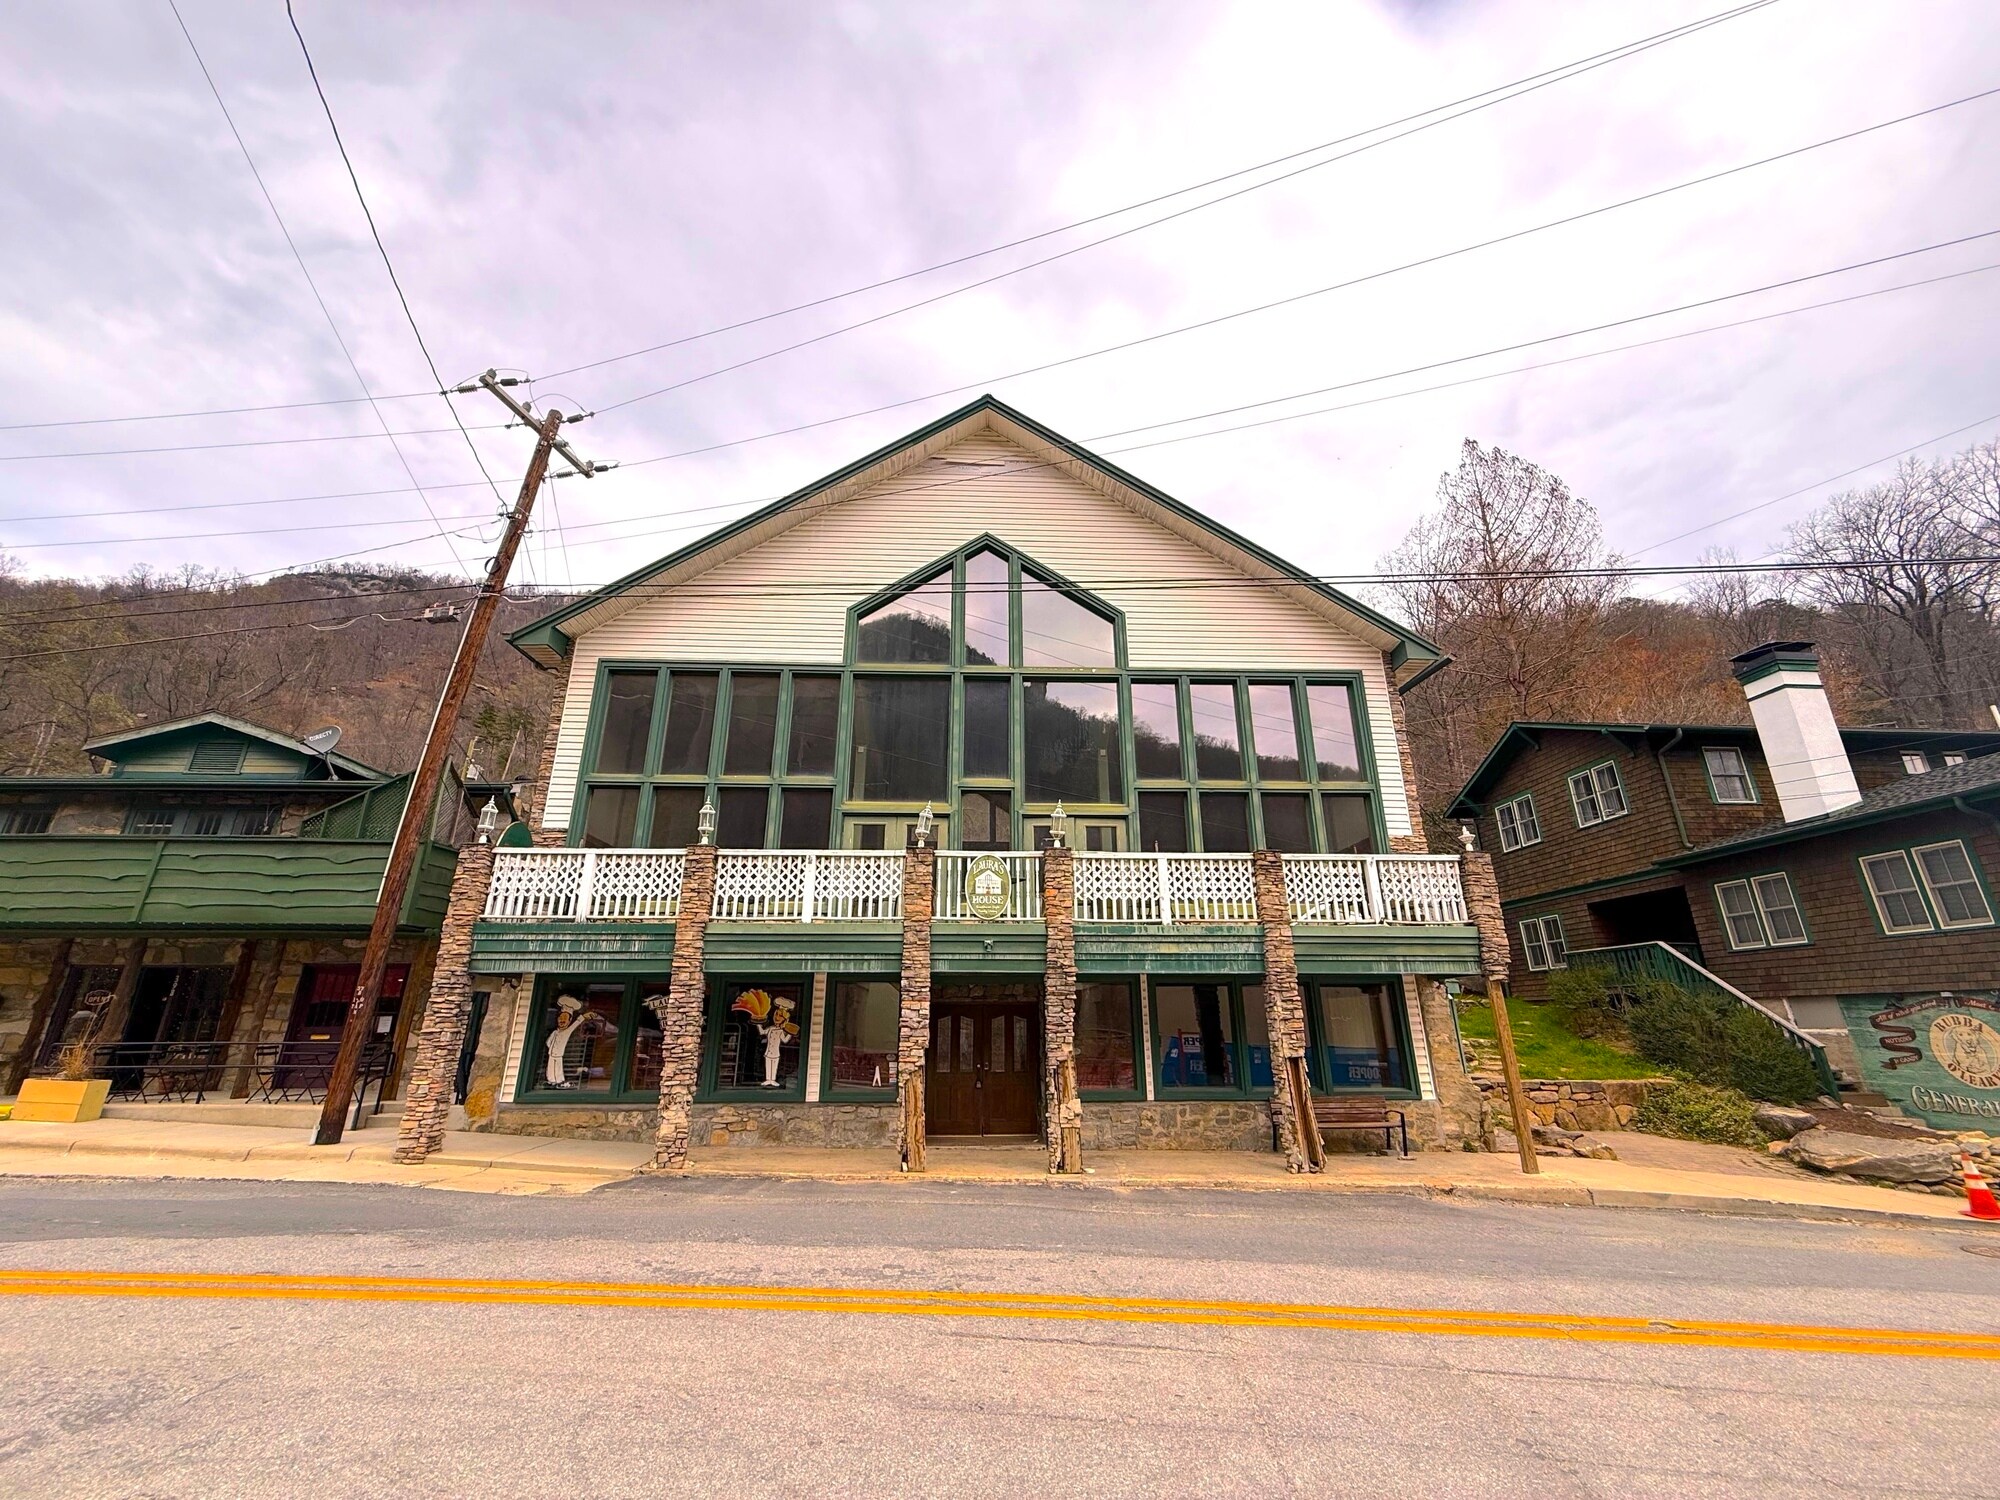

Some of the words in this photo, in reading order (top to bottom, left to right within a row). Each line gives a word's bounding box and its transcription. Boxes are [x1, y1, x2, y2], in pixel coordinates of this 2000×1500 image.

[973, 860, 1004, 875] LAURA'S
[972, 895, 1004, 905] HOUSE
[1934, 1016, 1984, 1033] BUBBA
